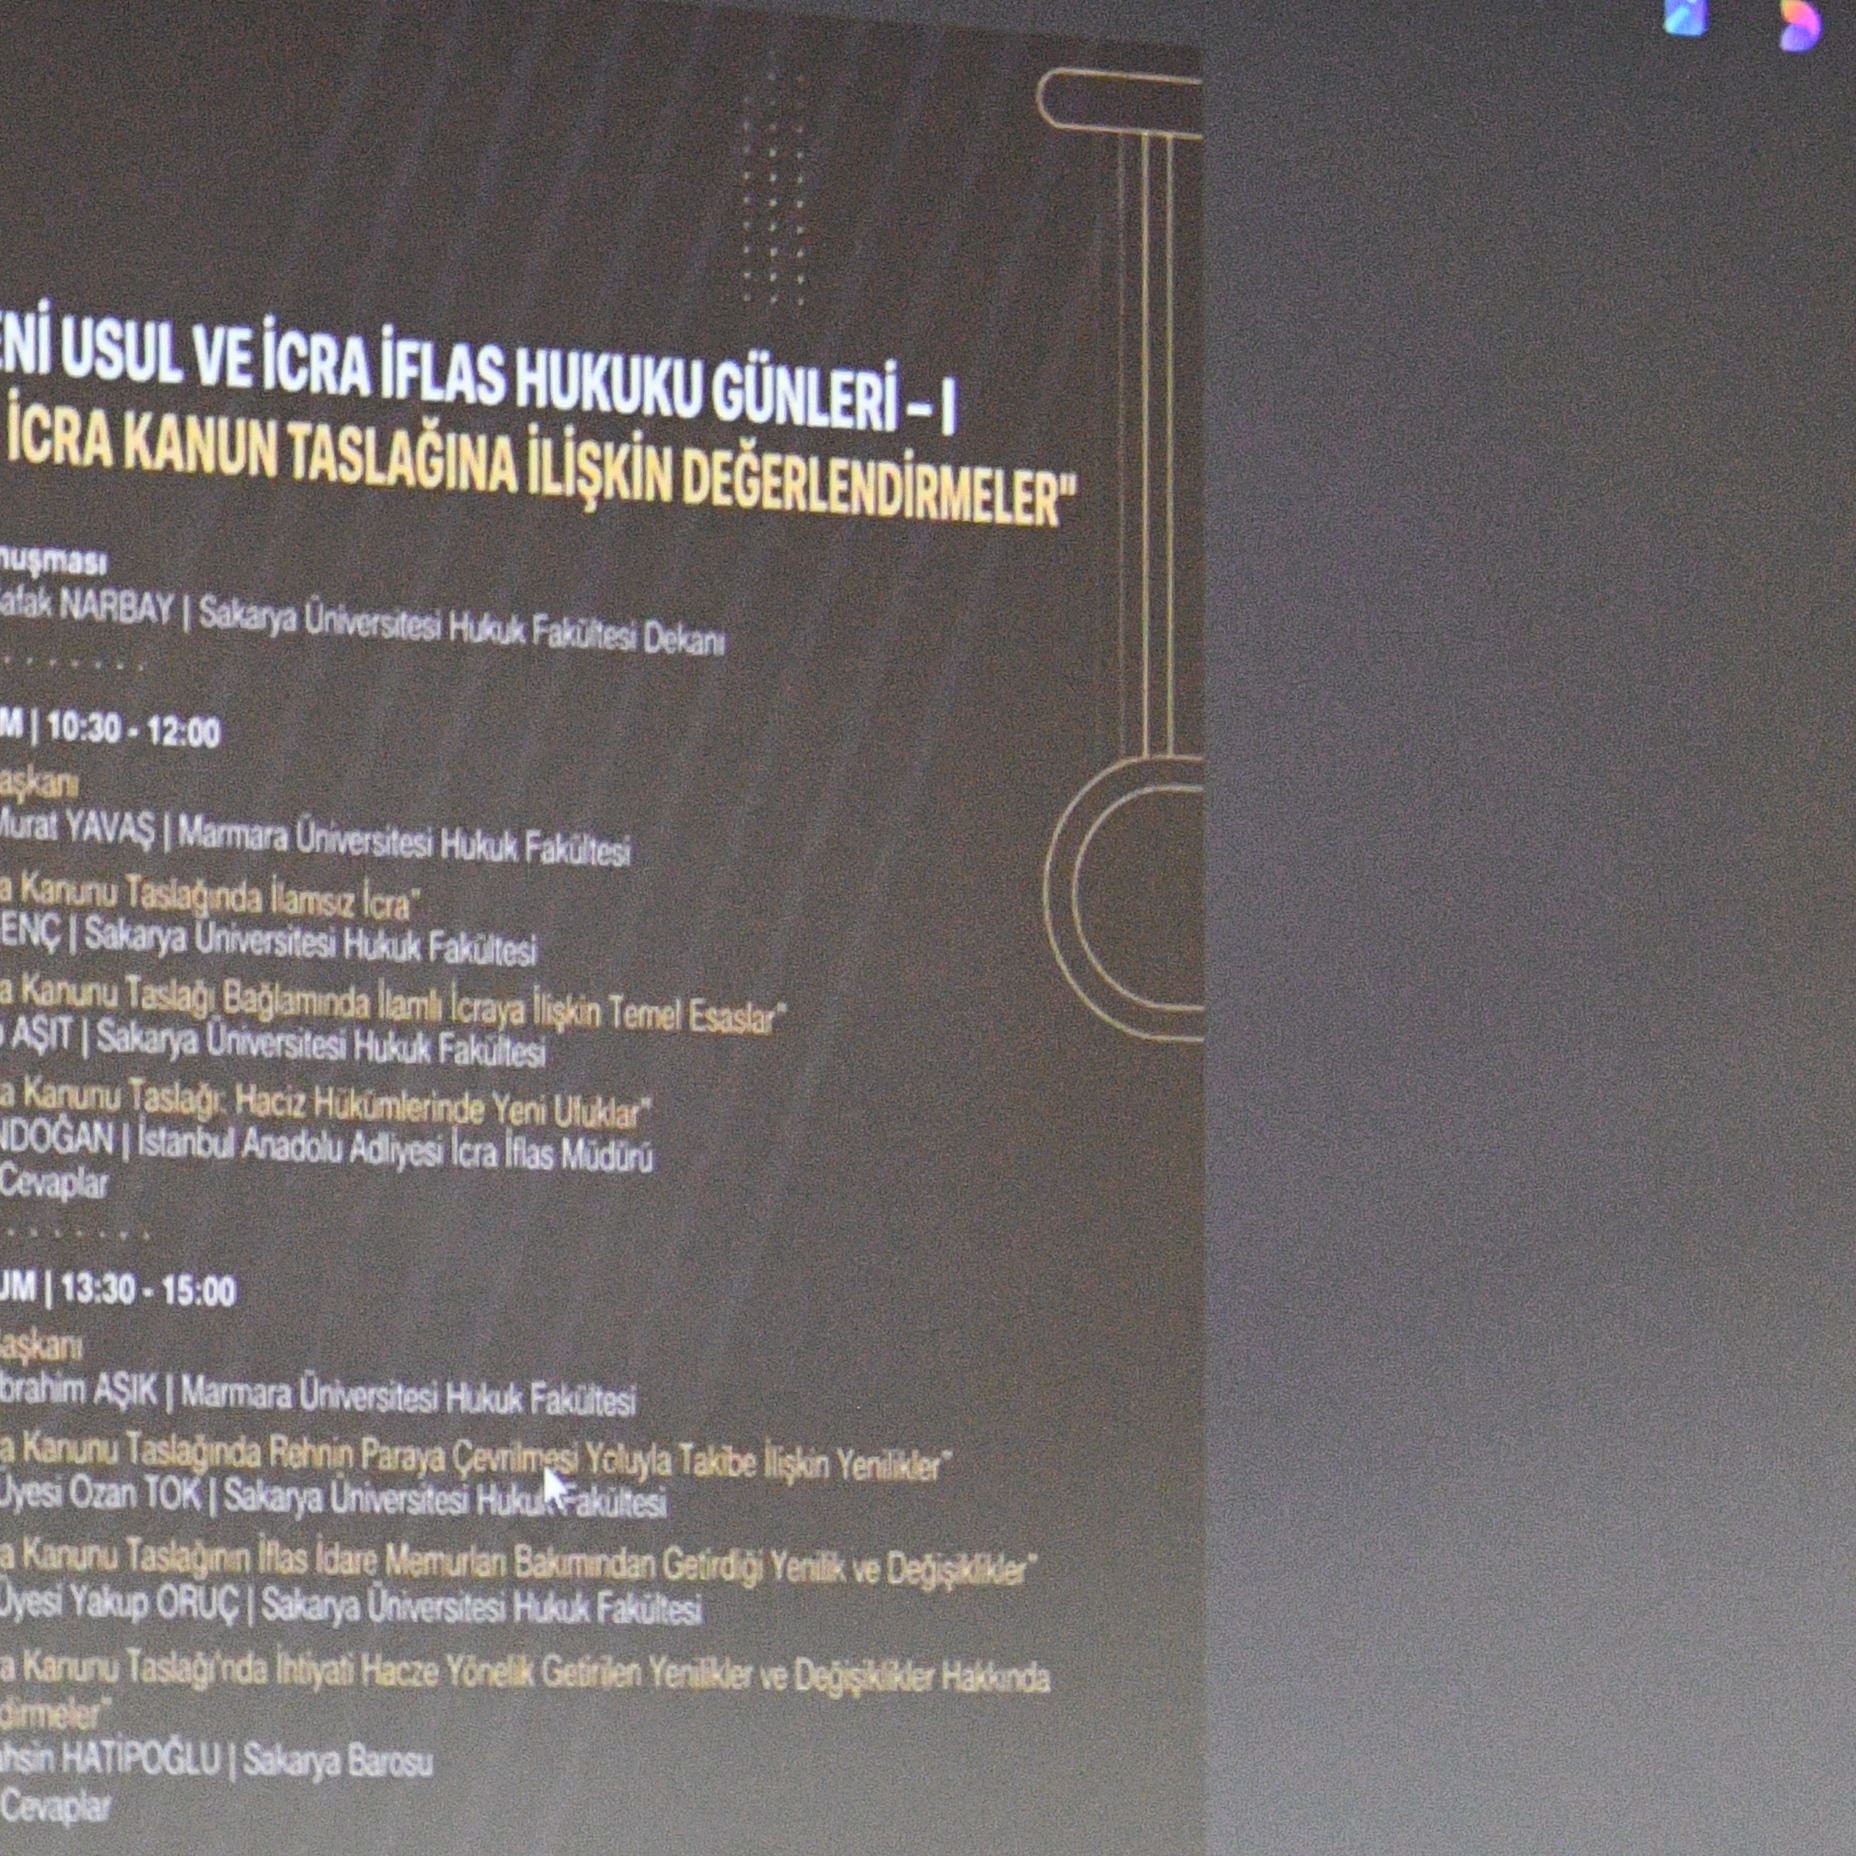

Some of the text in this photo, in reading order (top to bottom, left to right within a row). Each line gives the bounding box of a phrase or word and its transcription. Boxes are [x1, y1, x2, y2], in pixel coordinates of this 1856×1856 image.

[60, 315, 182, 383] USUL
[192, 323, 254, 387] VE
[261, 312, 372, 395] İCRA
[379, 320, 508, 404] İFLAS
[514, 345, 705, 417] HUKUKU
[711, 343, 901, 430] GÜNLERİ
[939, 372, 960, 434] I
[6, 390, 114, 470] İCRA
[122, 412, 279, 480] KANUN
[287, 415, 518, 494] TASLAĞINA
[526, 421, 674, 514] İLİŞKİN
[680, 434, 1078, 528] DEĞERLENDİRMELER"
[58, 586, 174, 626] NARBAY
[197, 593, 300, 640] Sakarya
[303, 590, 443, 641] Üniversitesi
[447, 607, 527, 645] Hukuk
[531, 612, 640, 652] Fakültesi
[641, 618, 728, 656] Dekanı
[47, 706, 124, 744] 10:30
[147, 711, 224, 749] 12:00
[66, 807, 156, 854] YAVAŞ
[176, 812, 291, 851] Marmara
[295, 808, 435, 858] Üniversitesi
[439, 824, 519, 862] Hukuk
[523, 828, 634, 867] Fakültesi
[84, 913, 187, 959] Sakarya
[194, 908, 337, 958] Üniversitesi
[343, 924, 422, 961] Hukuk
[427, 927, 541, 966] Fakültesi
[97, 1017, 199, 1062] Sakarya
[206, 1011, 347, 1060] Üniversitesi
[353, 1026, 431, 1063] Hukuk
[438, 1029, 547, 1067] Fakültesi
[136, 1113, 238, 1159] İstanbul
[240, 1125, 345, 1163] Anadolu
[349, 1129, 446, 1174] Adliyesi
[450, 1123, 500, 1168] İcra
[503, 1124, 557, 1170] İflas
[559, 1136, 656, 1173] Müdürü
[61, 1268, 138, 1305] 13:30
[162, 1271, 239, 1307] 15:00
[94, 1370, 158, 1414] AŞIK
[179, 1372, 295, 1409] Marmara
[297, 1365, 441, 1412] Üniversitesi
[444, 1378, 524, 1414] Hukuk
[529, 1380, 638, 1416] Fakültesi
[69, 1474, 136, 1509] Ozan
[144, 1475, 201, 1510] TOK
[224, 1477, 324, 1521] Sakarya
[330, 1469, 469, 1515] Üniversitesi
[70, 1582, 150, 1626] Yakup
[156, 1583, 239, 1627] ORUÇ
[262, 1585, 360, 1628] Sakarya
[367, 1576, 506, 1622] Üniversitesi
[512, 1588, 590, 1623] Hukuk
[596, 1589, 703, 1625] Fakültesi
[61, 1731, 223, 1775] HATİPOĞLU
[242, 1741, 343, 1784] Sakarya
[346, 1741, 435, 1776] Barosu
